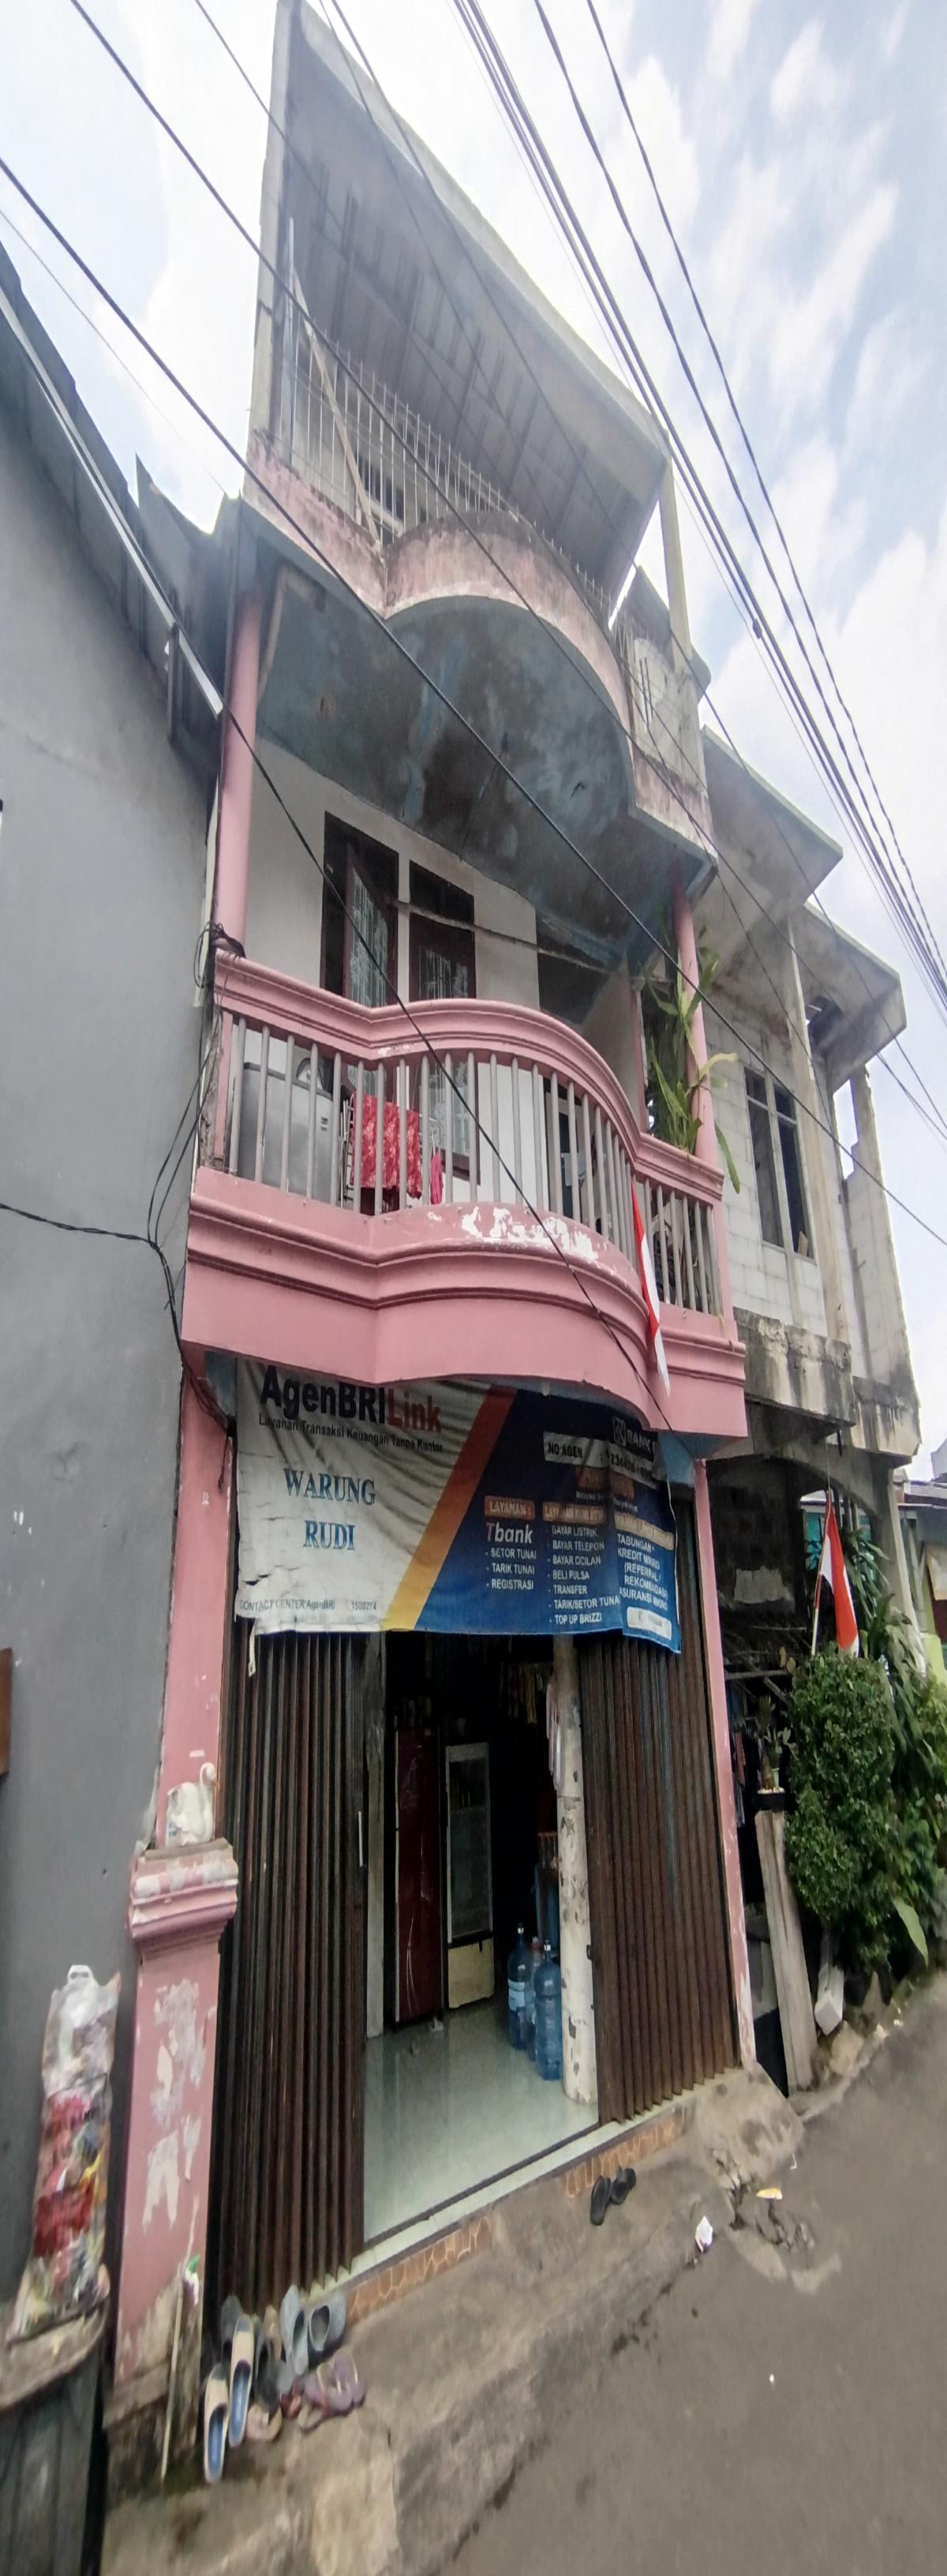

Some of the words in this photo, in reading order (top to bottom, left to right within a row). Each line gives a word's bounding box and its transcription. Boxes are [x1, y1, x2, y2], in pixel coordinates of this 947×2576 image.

[260, 1365, 442, 1433] AgenBRILink
[259, 1413, 298, 1432] Layanan
[302, 1422, 344, 1439] Transaksi
[627, 1431, 651, 1454] BANK
[283, 1468, 376, 1505] WARUNG
[489, 1502, 526, 1515] LAYANAN
[303, 1520, 355, 1550] RUDI
[486, 1522, 533, 1544] Tbank
[573, 1526, 597, 1538] LISTRIK
[552, 1540, 573, 1551] BAYAR
[575, 1541, 605, 1552] TELEPON
[491, 1548, 515, 1559] SETOR
[517, 1549, 537, 1559] TUNAI
[618, 1547, 642, 1563] KREDIT
[552, 1555, 574, 1565] BAYAR
[575, 1556, 601, 1566] CICILAN
[492, 1563, 511, 1574] TARIK
[514, 1564, 534, 1574] TUNAI
[552, 1569, 567, 1580] BELI
[569, 1570, 590, 1580] PULSA
[491, 1578, 534, 1590] REGISTRASI
[553, 1584, 588, 1594] TRANSFER
[619, 1586, 653, 1604] ASURANSI
[240, 1600, 274, 1611] CONTACT
[555, 1615, 568, 1625] TOP
[569, 1614, 578, 1624] UP
[579, 1612, 603, 1623] BRIZZI
